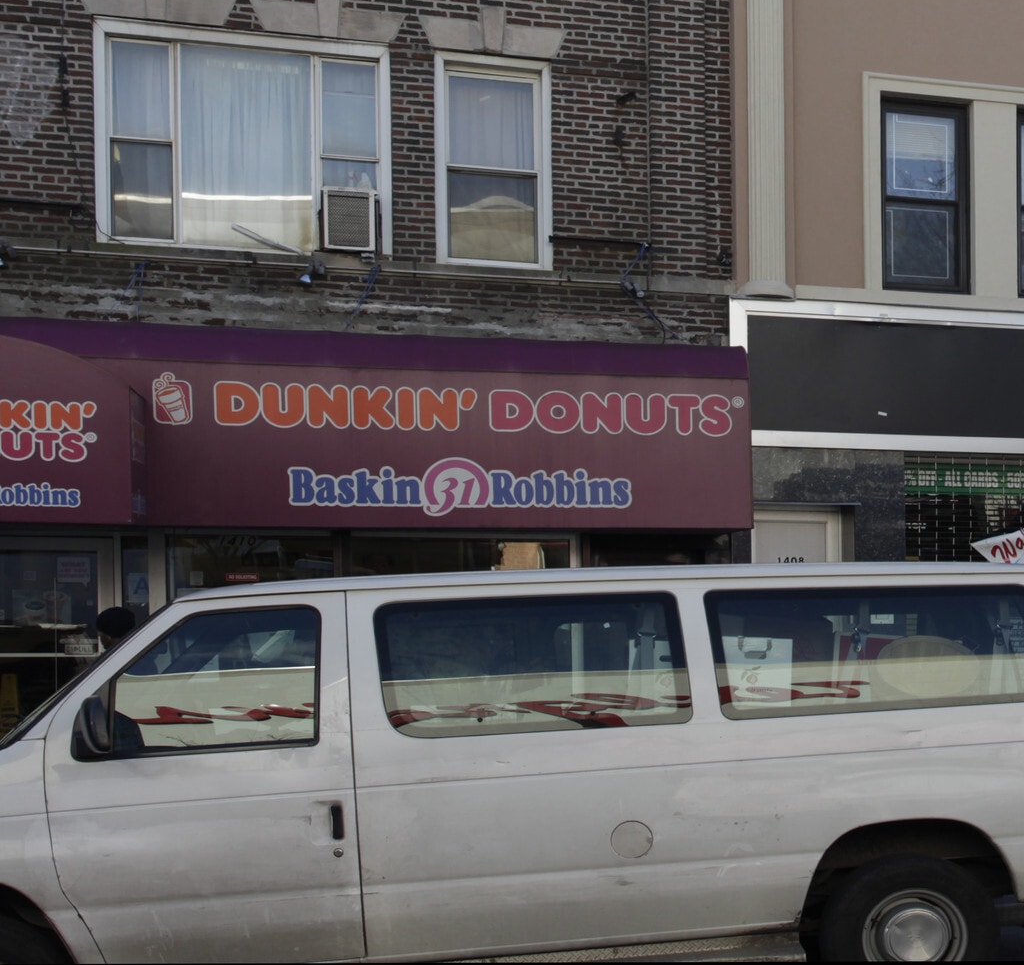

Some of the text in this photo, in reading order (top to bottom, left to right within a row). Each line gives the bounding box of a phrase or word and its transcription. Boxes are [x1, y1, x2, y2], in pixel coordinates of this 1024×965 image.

[213, 381, 477, 432] DUNKIN'
[288, 466, 632, 516] Baskin 31 Robbins
[918, 470, 937, 486] OFF
[944, 471, 962, 487] ALL
[964, 471, 999, 488] CARDS
